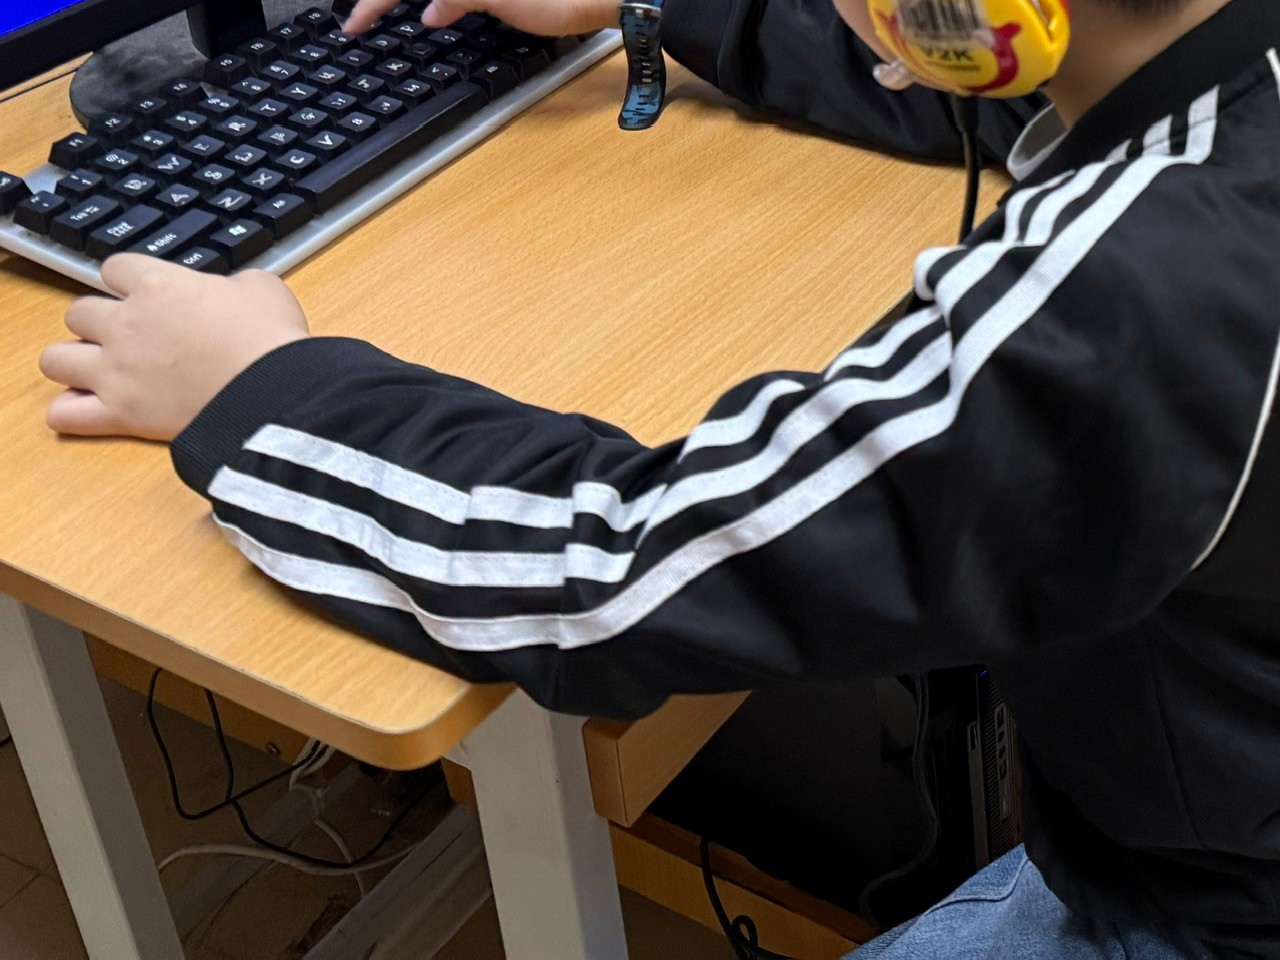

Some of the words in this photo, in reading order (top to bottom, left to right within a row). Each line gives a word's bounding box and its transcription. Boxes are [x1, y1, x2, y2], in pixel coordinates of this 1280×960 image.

[105, 117, 120, 128] F2
[316, 134, 334, 146] V
[157, 156, 180, 170] W
[289, 155, 305, 165] C
[203, 170, 223, 180] S
[252, 172, 273, 186] X
[123, 179, 147, 191] Q
[170, 193, 190, 203] A
[217, 196, 243, 208] Z
[156, 233, 178, 248] Shift
